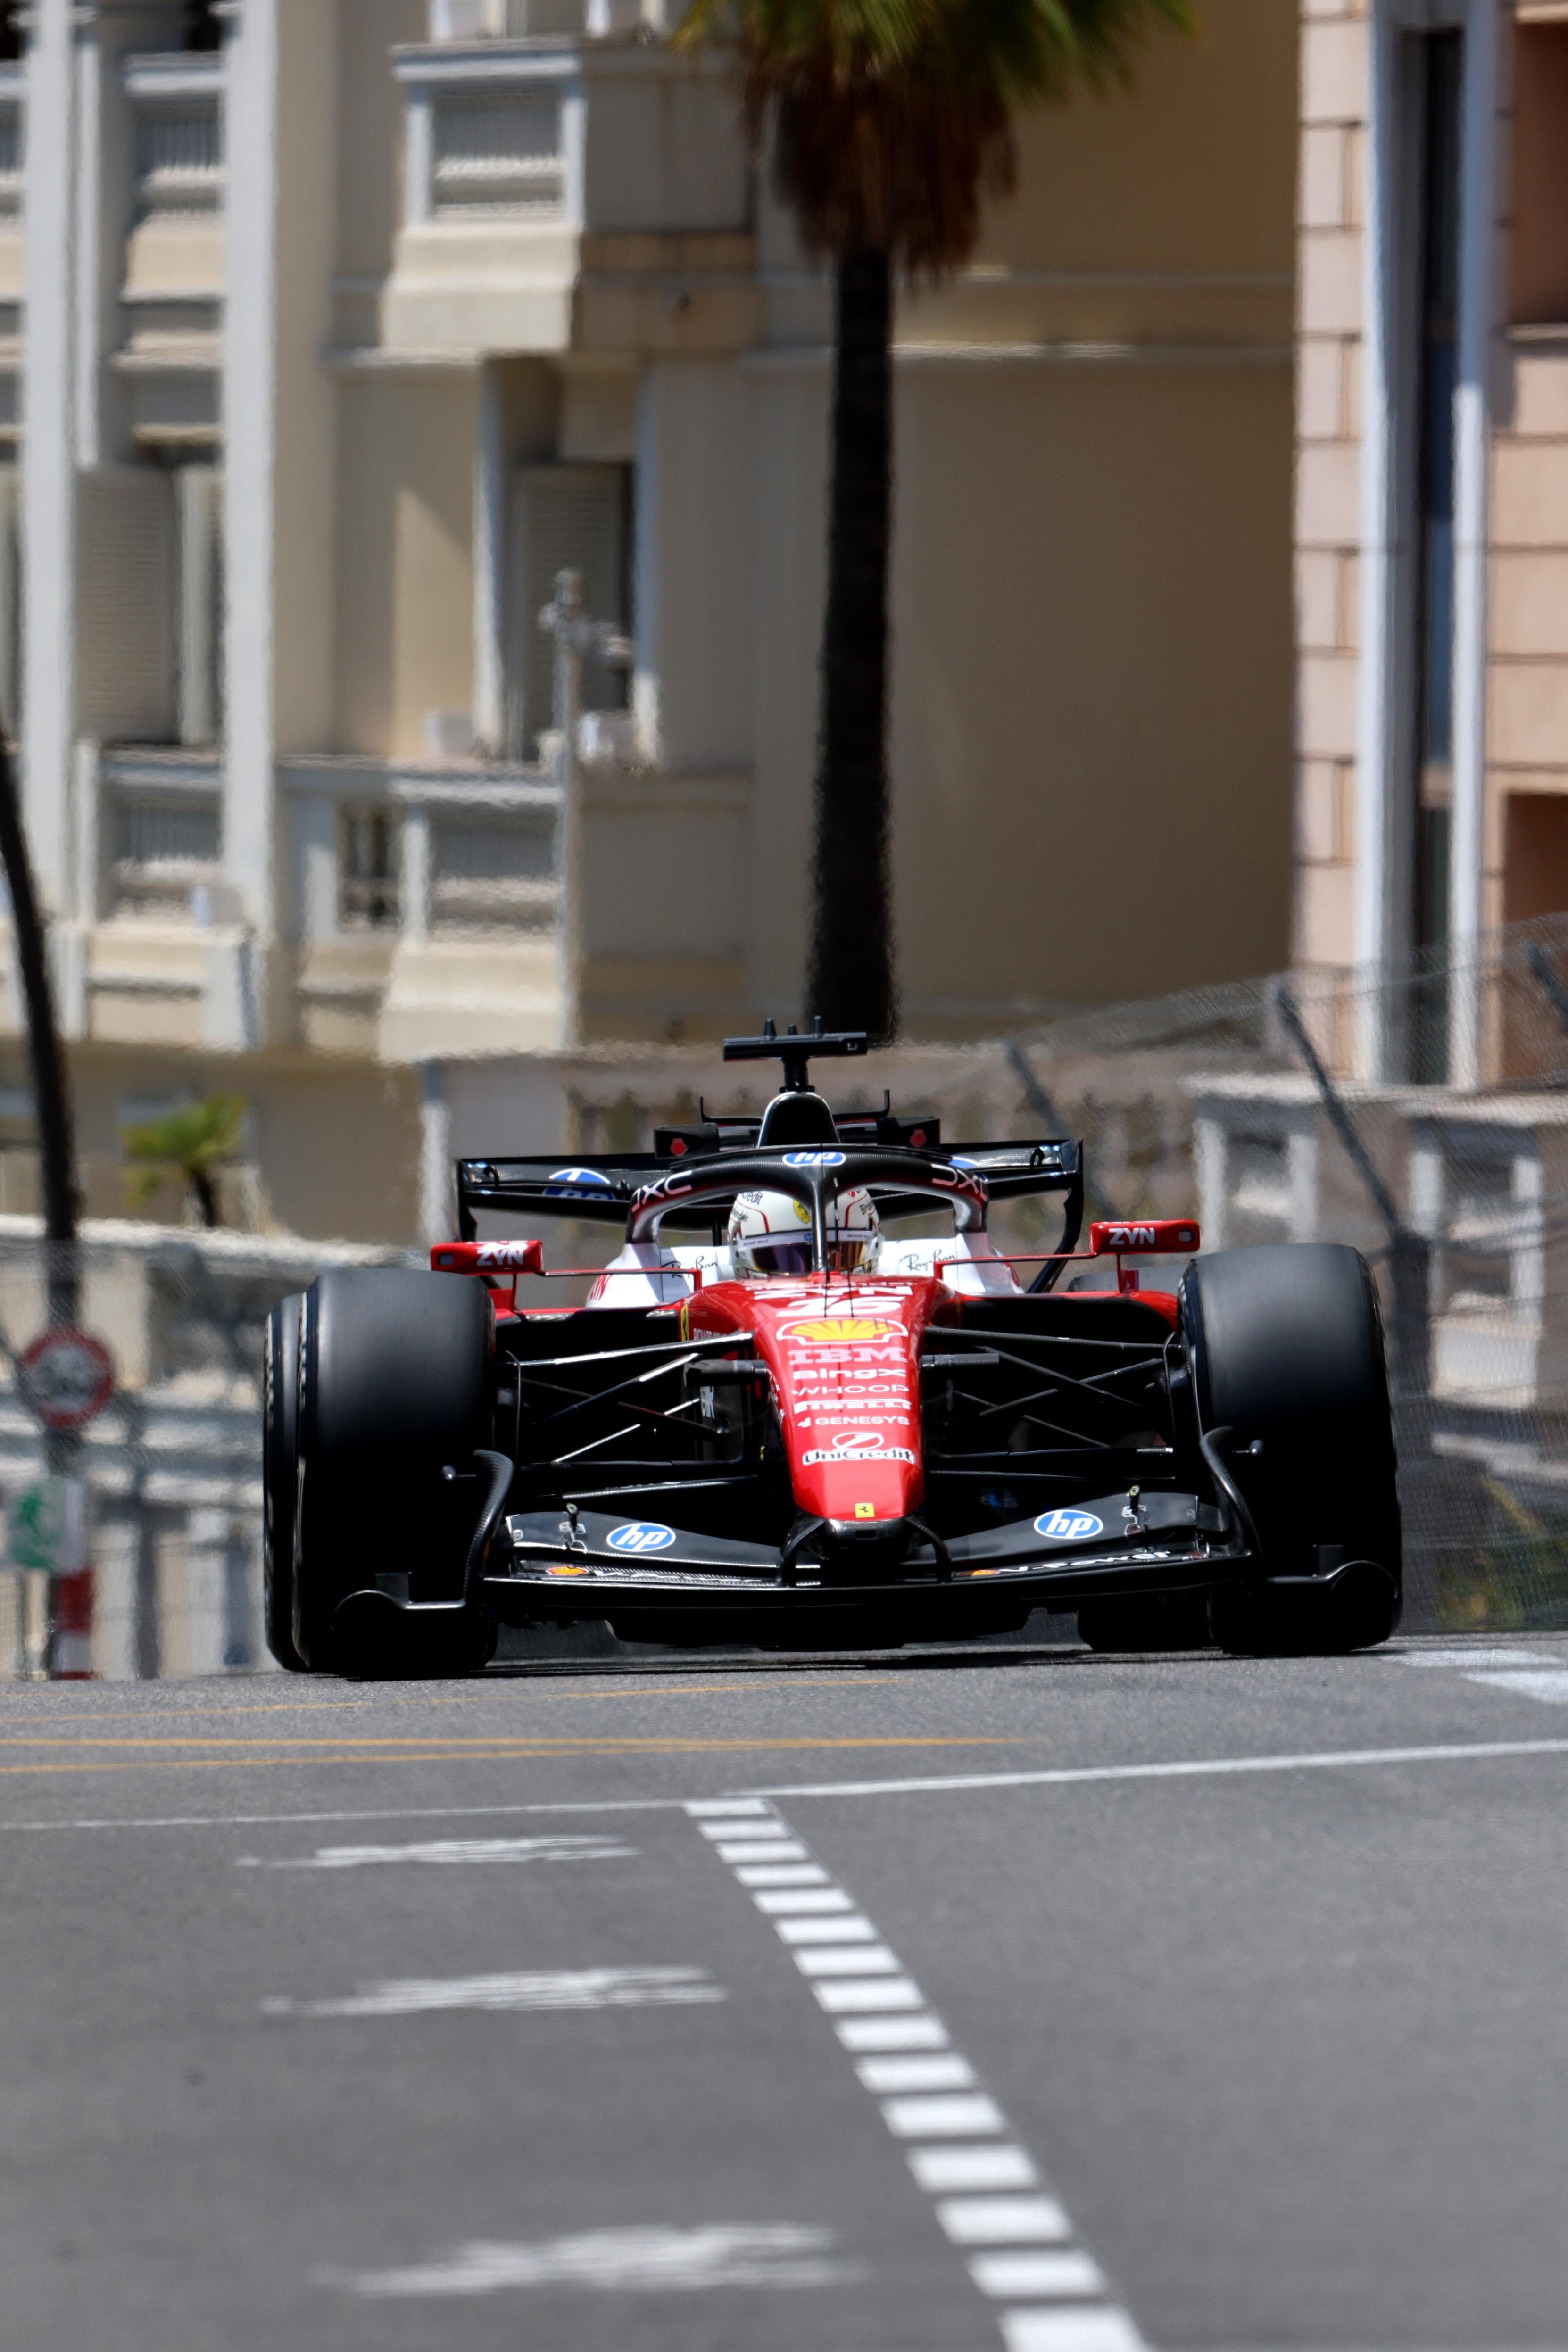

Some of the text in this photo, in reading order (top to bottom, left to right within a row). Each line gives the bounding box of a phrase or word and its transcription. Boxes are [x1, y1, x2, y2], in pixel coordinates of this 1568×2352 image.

[1108, 1227, 1155, 1245] ZYN
[476, 1248, 524, 1267] ZYN
[900, 1249, 956, 1271] Ray-Ban
[788, 1347, 908, 1366] IBM
[791, 1384, 910, 1396] WHOOP
[793, 1398, 912, 1415] PIRELLI
[815, 1416, 911, 1425] GENESYS
[804, 1449, 915, 1462] UniCredit
[1045, 1511, 1093, 1538] hp
[616, 1524, 662, 1551] hp
